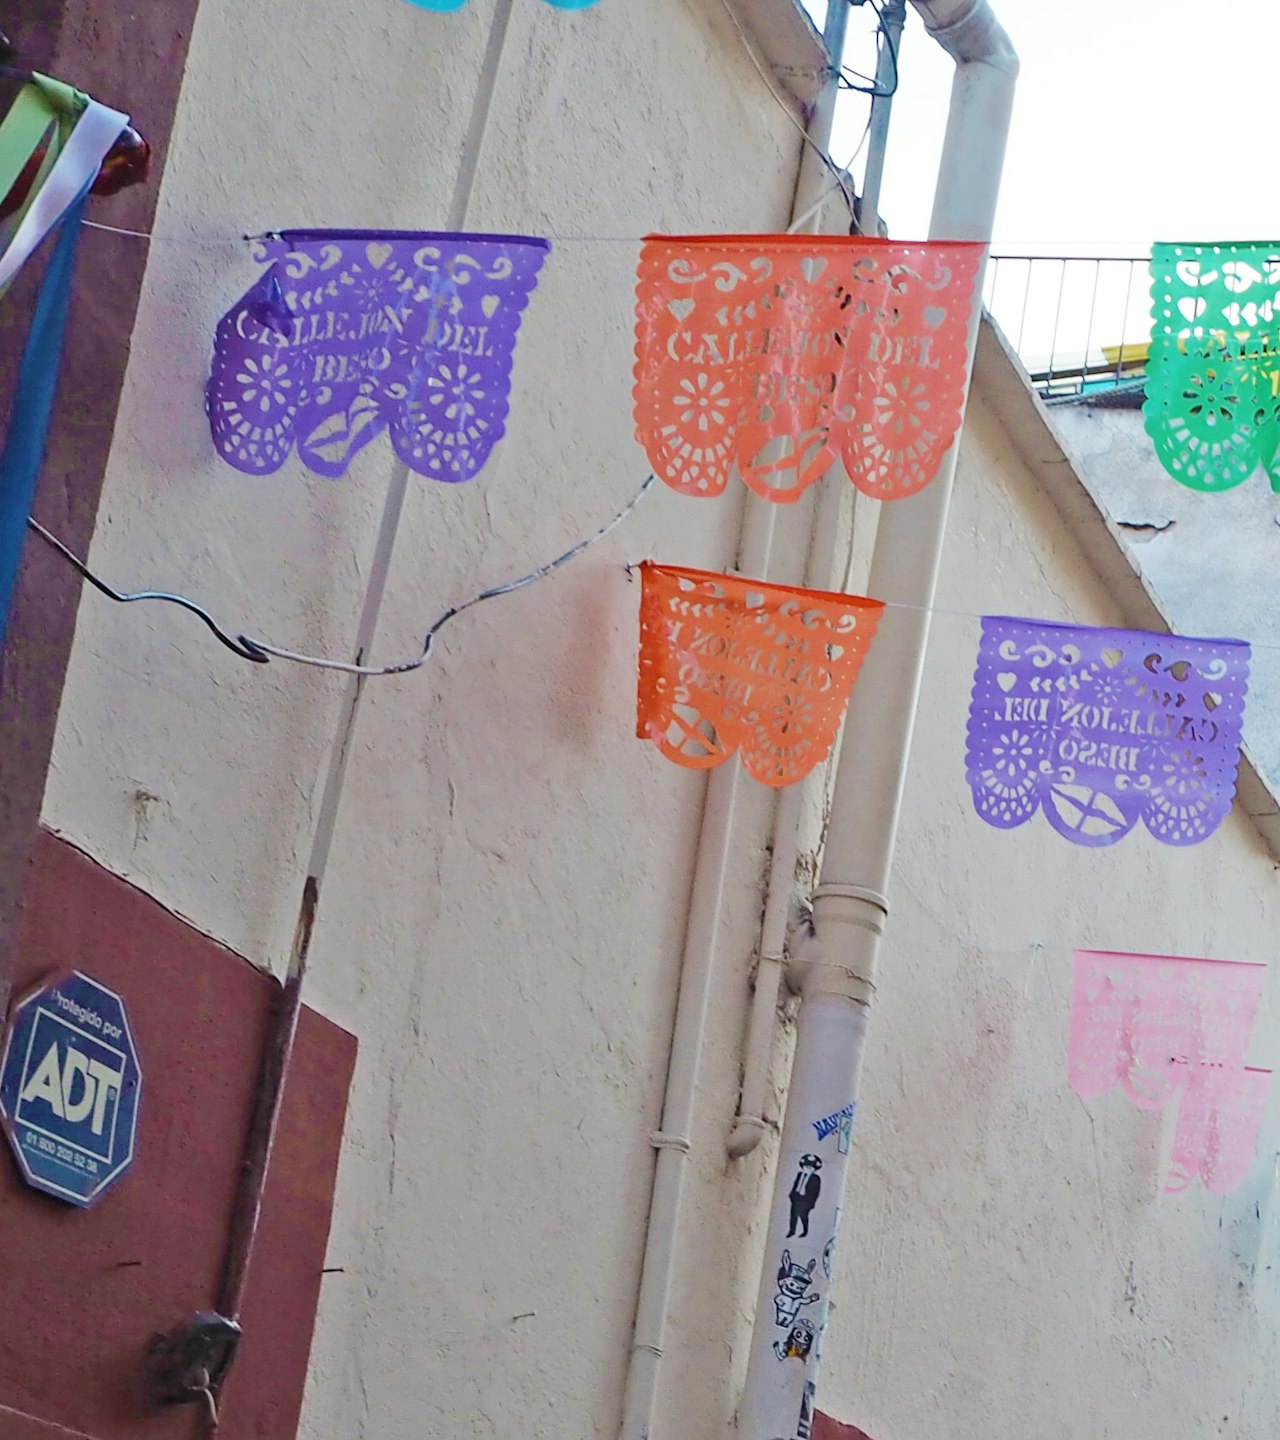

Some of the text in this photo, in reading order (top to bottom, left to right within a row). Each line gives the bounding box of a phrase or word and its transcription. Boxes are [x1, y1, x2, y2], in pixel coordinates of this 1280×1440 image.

[421, 320, 493, 357] DEL
[868, 331, 942, 370] DEL
[102, 1020, 123, 1039] por
[21, 1040, 122, 1136] ADT
